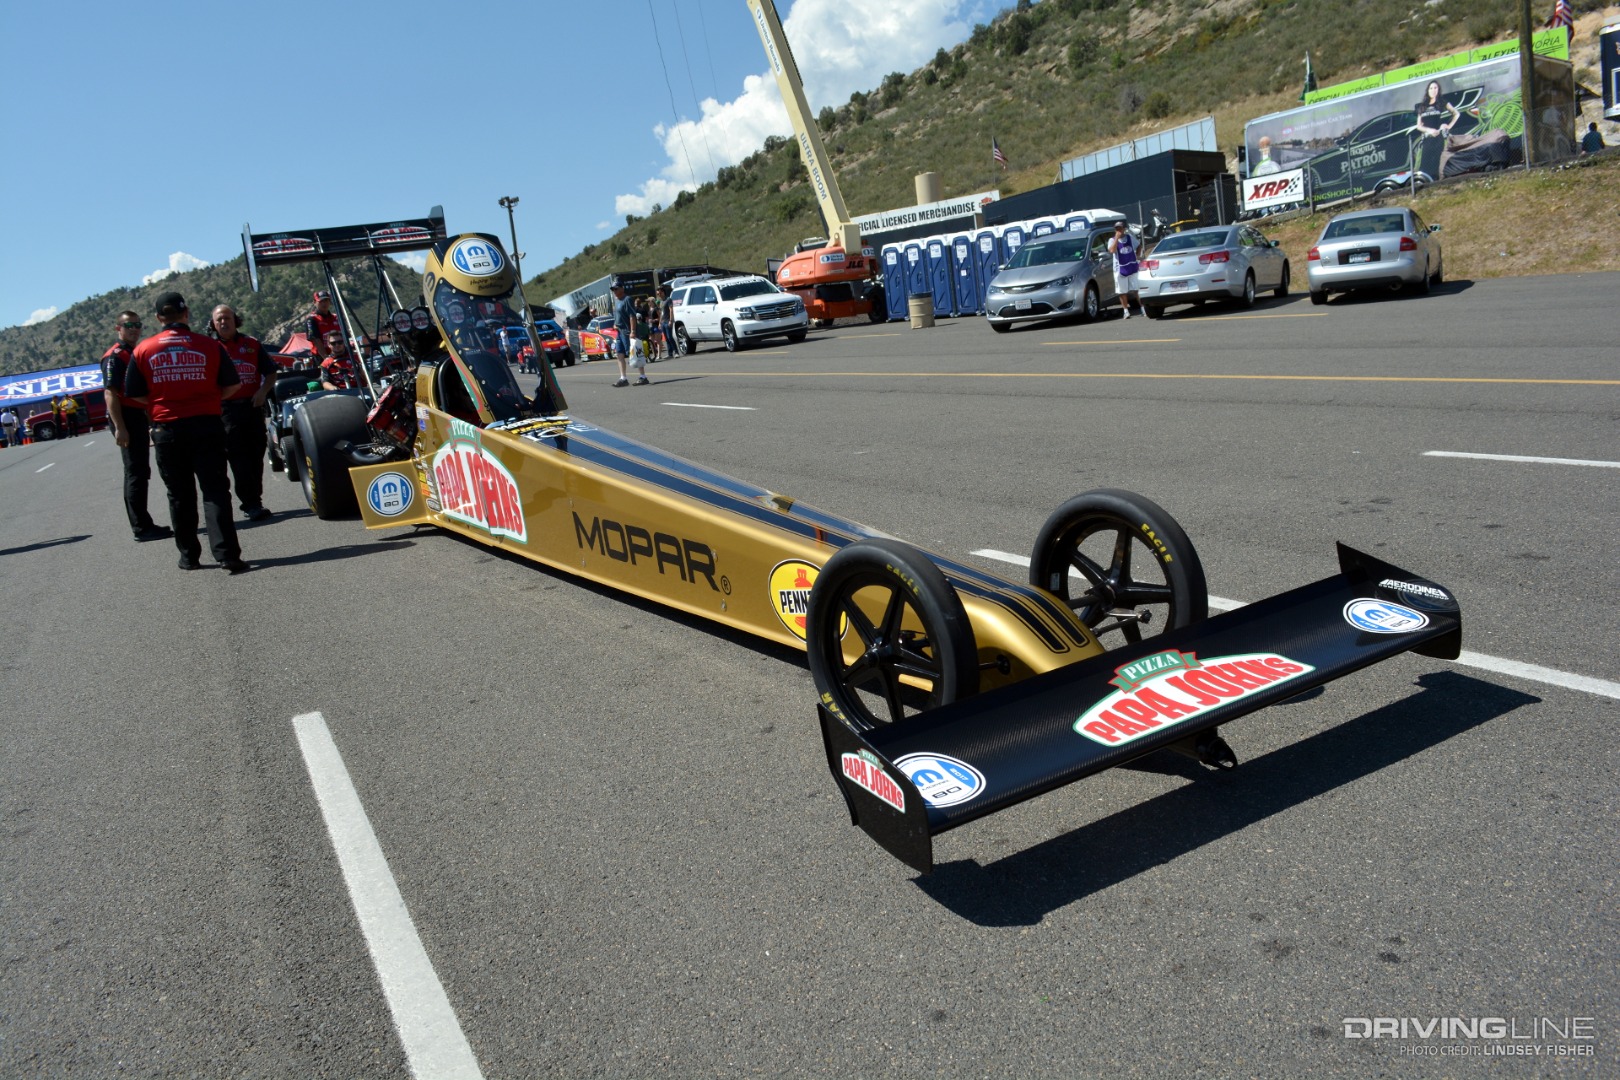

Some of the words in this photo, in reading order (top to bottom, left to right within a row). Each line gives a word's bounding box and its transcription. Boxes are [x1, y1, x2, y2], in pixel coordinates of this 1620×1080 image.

[800, 133, 814, 167] ULTRA
[812, 168, 827, 200] BOOM
[1247, 178, 1291, 201] XRP
[882, 213, 917, 228] LICENSED
[919, 202, 976, 221] MERCHANDISE
[472, 261, 491, 269] 80
[846, 260, 864, 269] JLG
[151, 352, 174, 369] PAPA
[8, 374, 104, 395] NHR
[153, 374, 181, 383] BETTER
[452, 420, 475, 439] PIZZA
[436, 451, 473, 514] PAPA
[1141, 523, 1173, 564] EAGLE
[886, 563, 920, 597] EAGLE
[1123, 653, 1180, 680] PIZZA
[1083, 687, 1200, 743] PAPA
[862, 750, 878, 764] PIZZA
[843, 757, 869, 787] PAPA
[949, 767, 969, 781] 2017
[932, 786, 962, 799] 80
